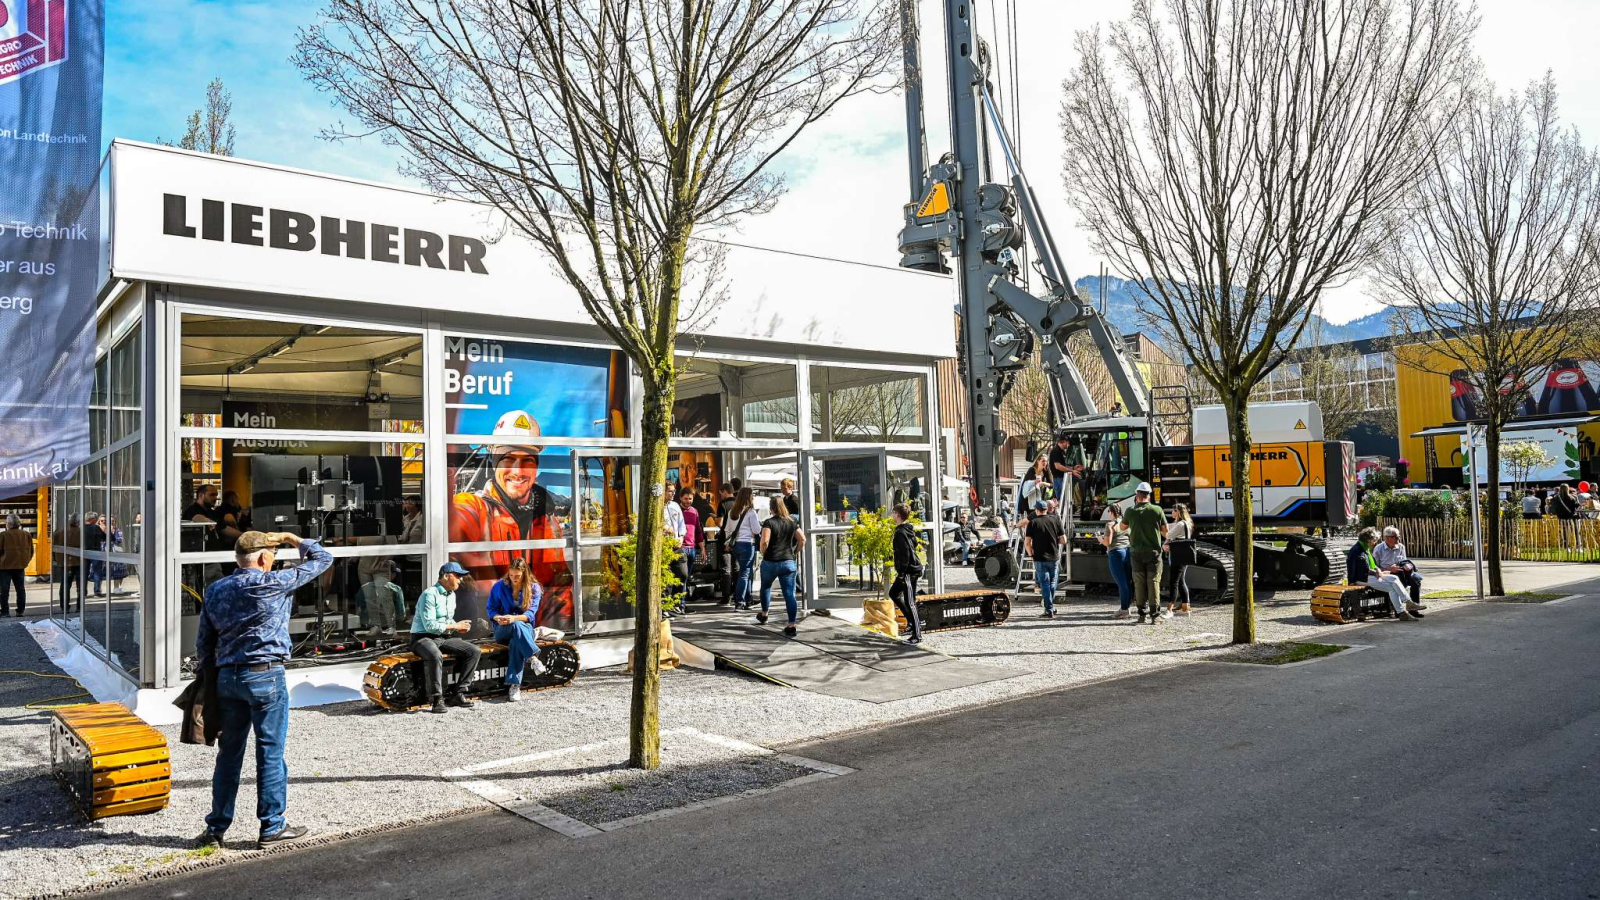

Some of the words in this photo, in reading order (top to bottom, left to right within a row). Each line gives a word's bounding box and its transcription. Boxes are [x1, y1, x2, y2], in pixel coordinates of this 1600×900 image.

[0, 40, 21, 54] GRO
[0, 54, 38, 75] ECHNIK
[14, 129, 87, 143] Landtechnik
[11, 220, 87, 240] Technik
[163, 193, 489, 275] LIEBHERR
[19, 260, 56, 276] aus
[445, 337, 504, 363] Mein
[445, 368, 514, 396] Beruf
[233, 412, 276, 428] Mein
[1221, 451, 1288, 462] LIHERR
[943, 606, 981, 618] LIEBHERR
